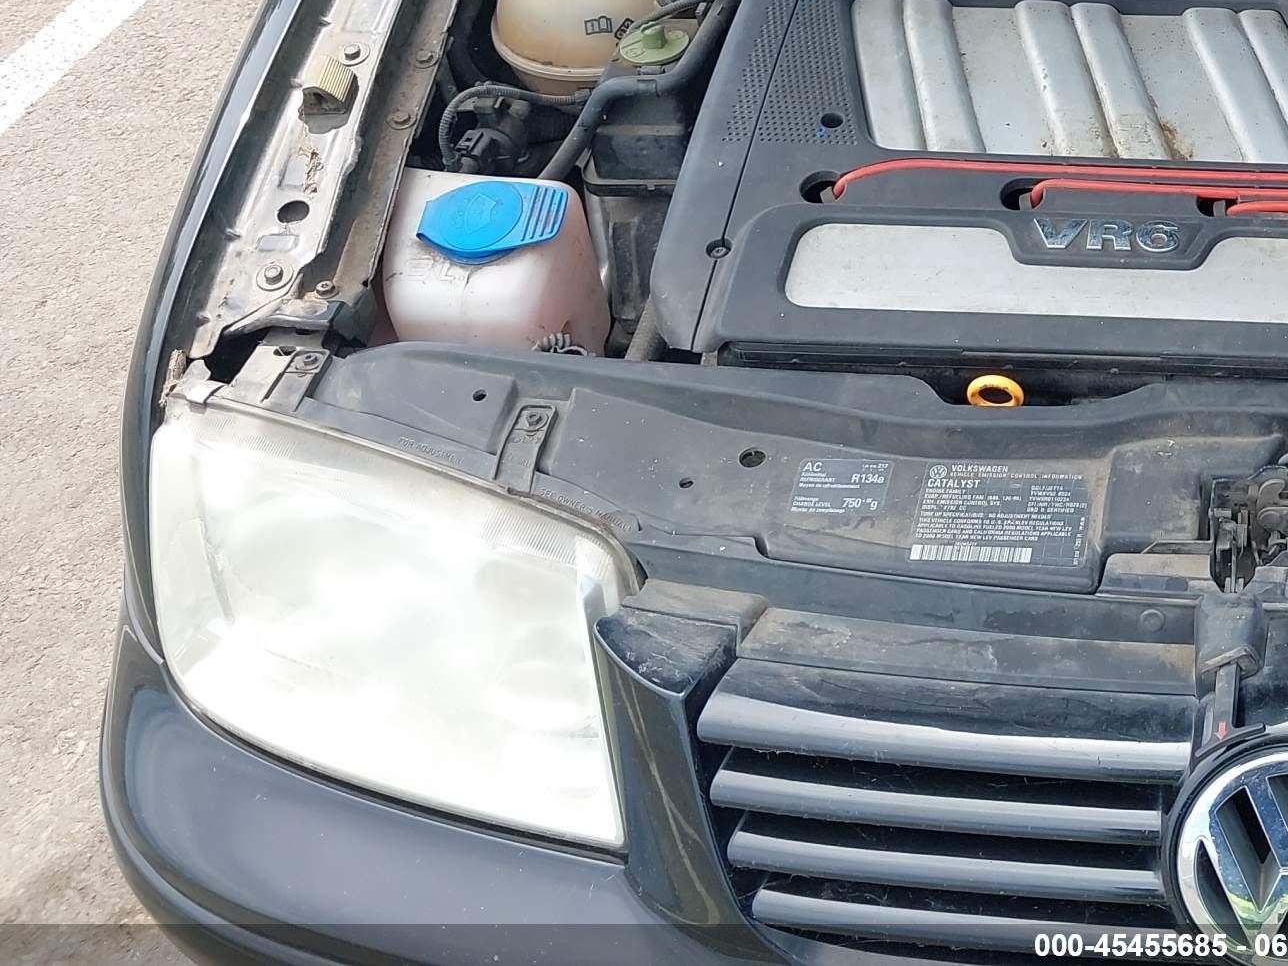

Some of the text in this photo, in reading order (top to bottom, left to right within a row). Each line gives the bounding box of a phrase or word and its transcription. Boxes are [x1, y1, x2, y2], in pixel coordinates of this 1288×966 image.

[1033, 216, 1181, 254] VR6
[803, 462, 822, 472] AC
[951, 465, 1009, 473] VOLKSWAGEN
[851, 473, 885, 484] R134a
[927, 479, 981, 488] CATALYST
[842, 497, 861, 508] 750
